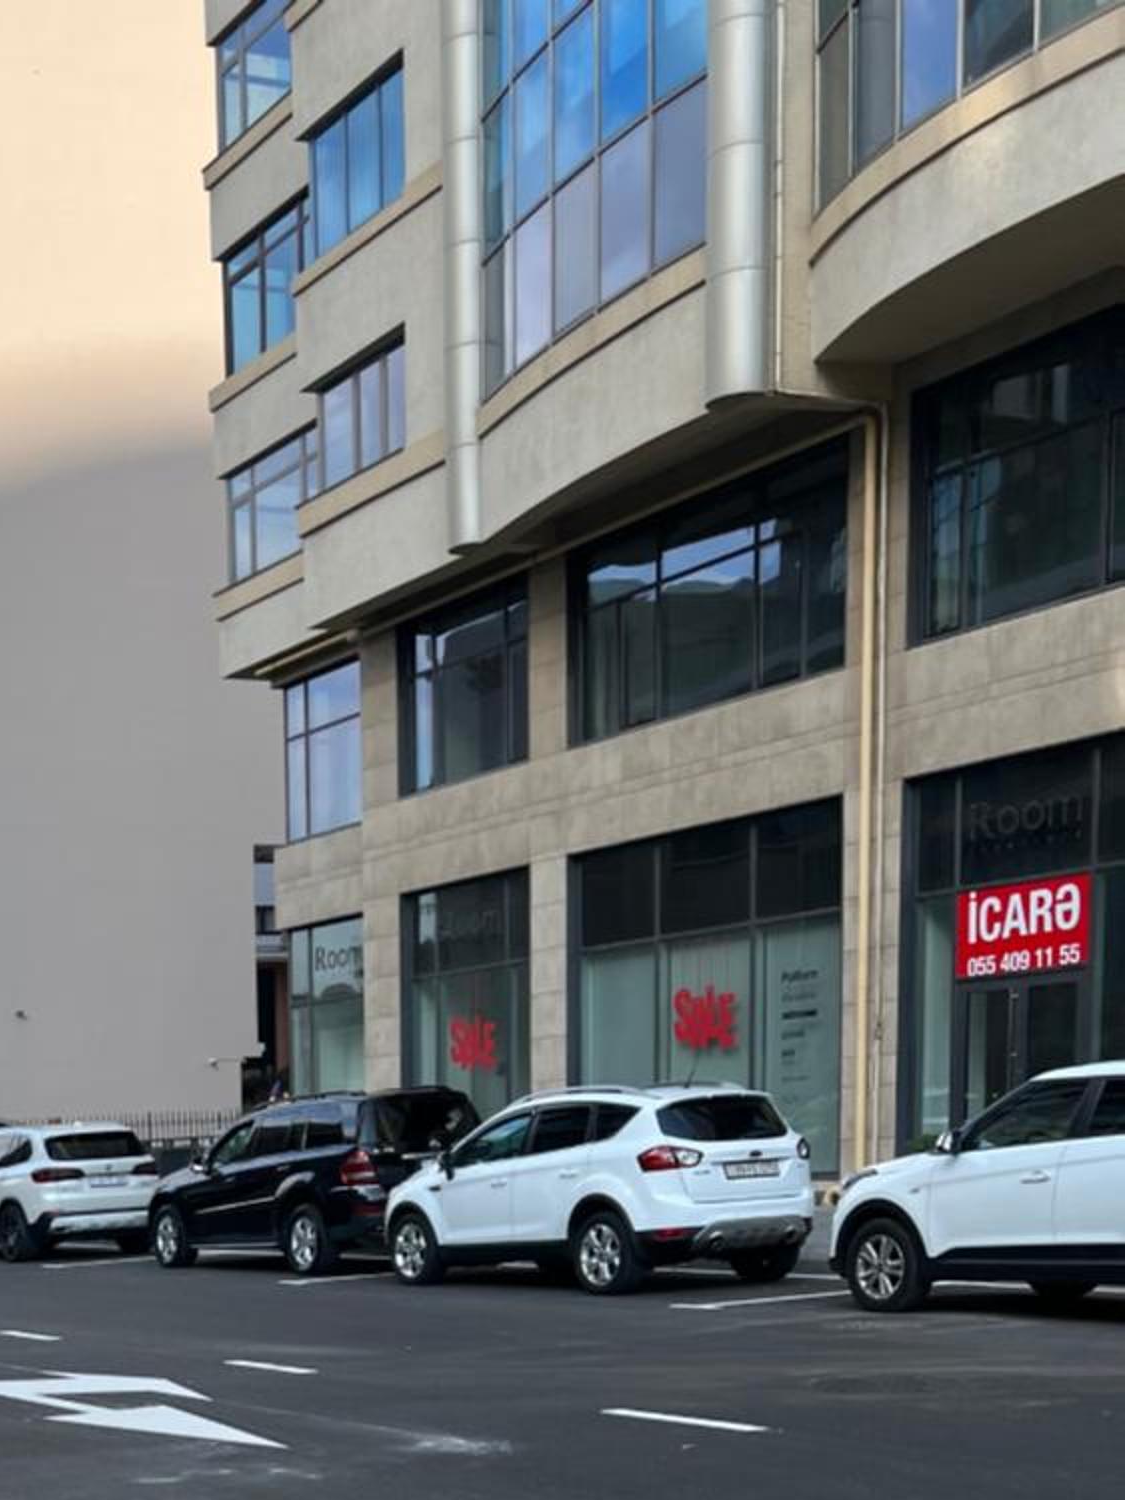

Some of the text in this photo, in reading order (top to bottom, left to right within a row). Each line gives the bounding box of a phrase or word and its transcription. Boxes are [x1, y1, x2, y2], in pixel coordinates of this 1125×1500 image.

[968, 884, 1080, 944] İCARƏ
[967, 943, 1081, 977] 055 409 11 55
[673, 983, 738, 1051] SALE
